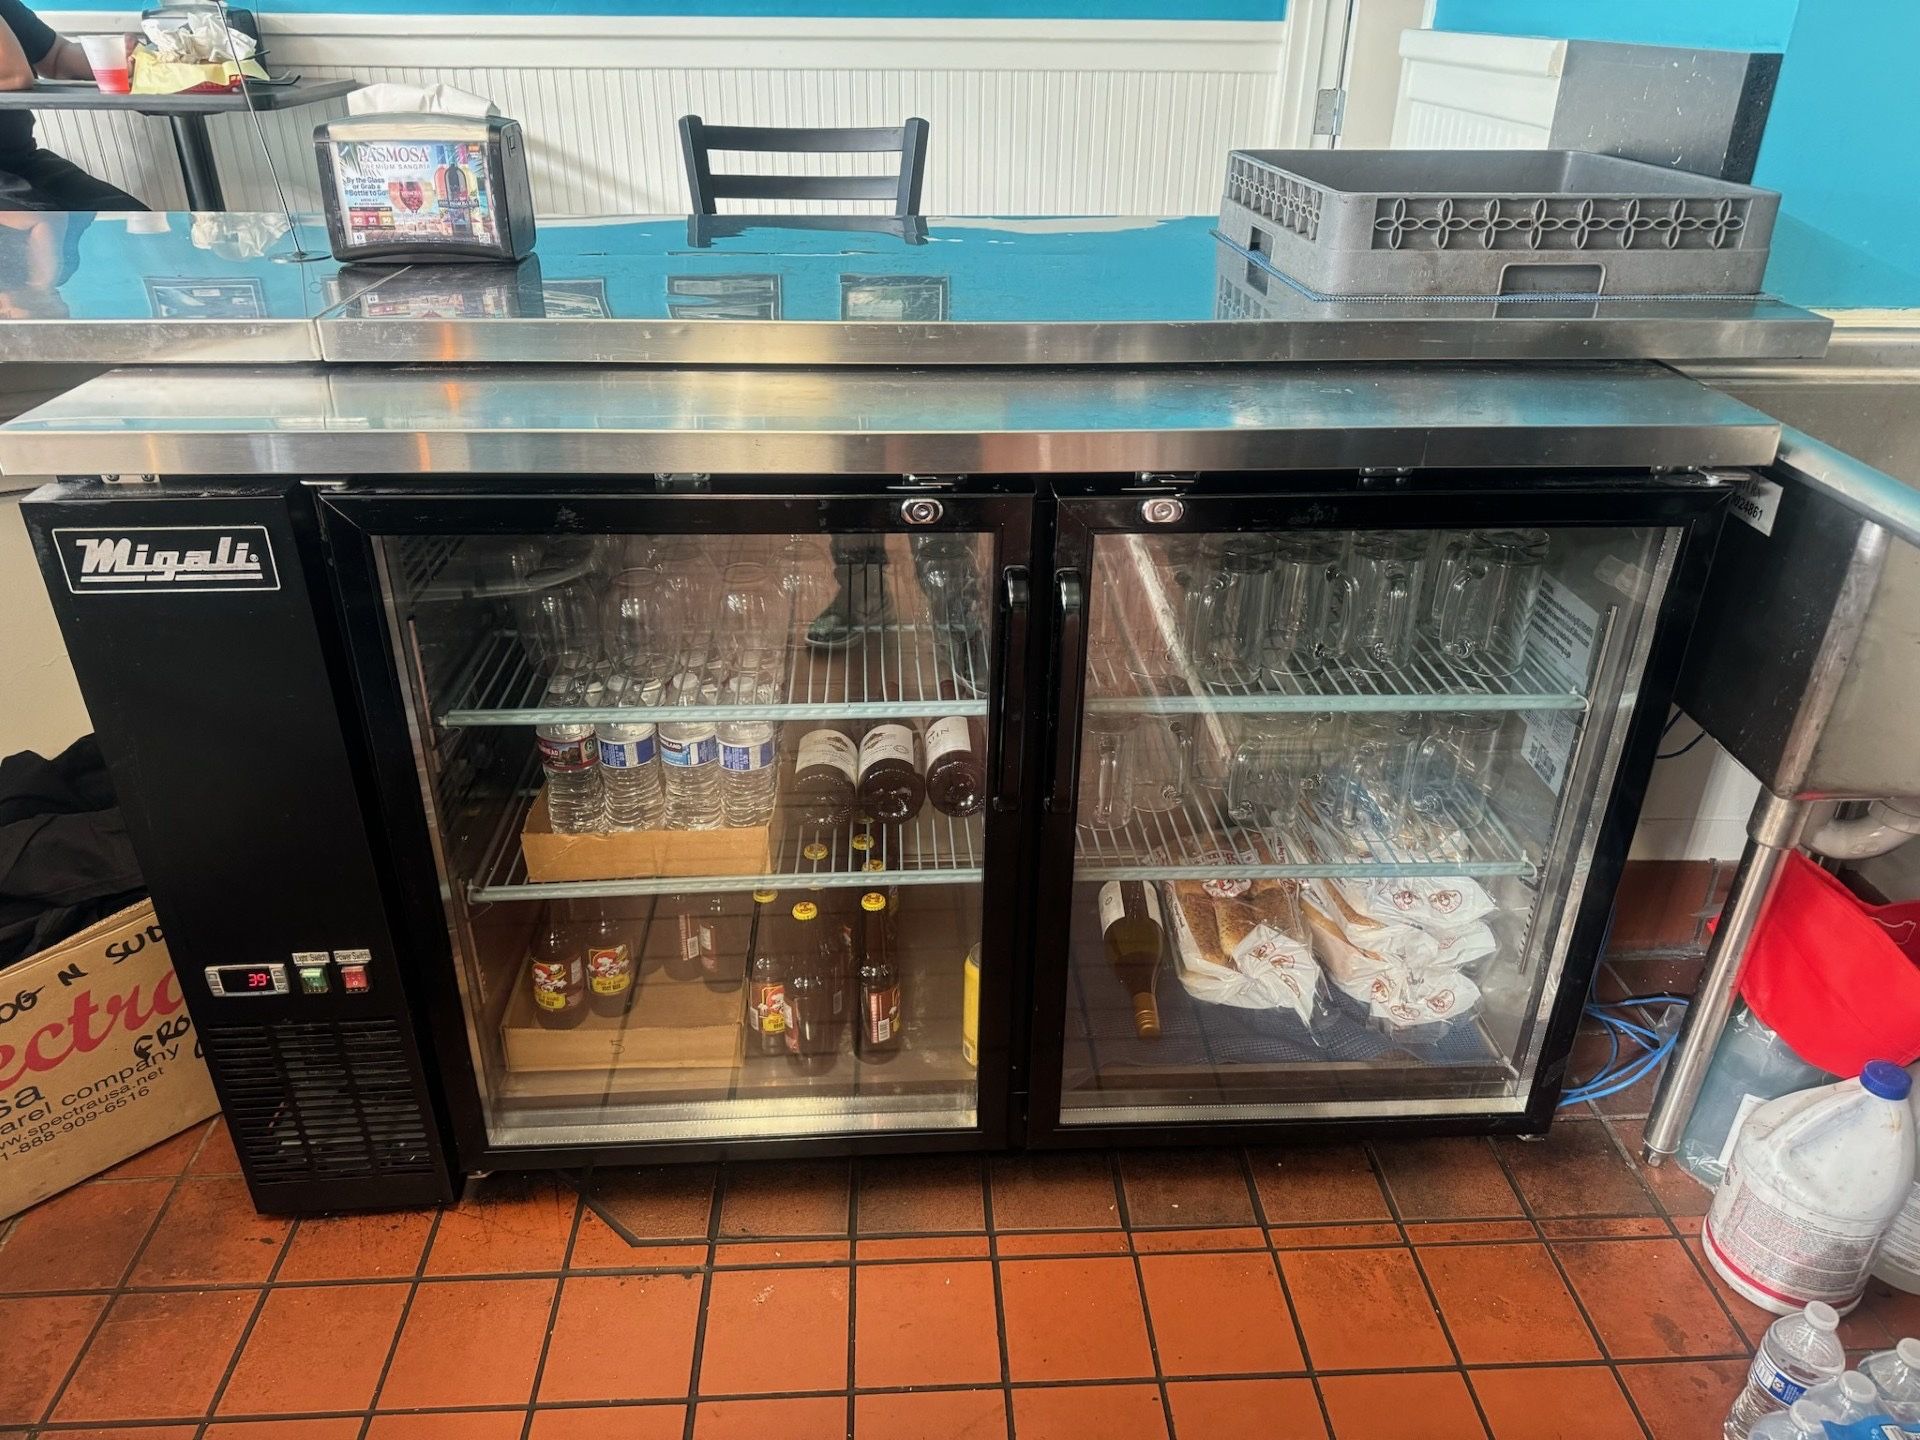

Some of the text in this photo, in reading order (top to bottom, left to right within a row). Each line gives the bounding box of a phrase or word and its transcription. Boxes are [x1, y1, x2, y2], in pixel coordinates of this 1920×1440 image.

[358, 146, 429, 162] PASMOSA
[76, 536, 261, 582] Migali
[247, 973, 267, 987] 39
[61, 1043, 179, 1107] company
[1, 1086, 150, 1161] 1-888-909-6516
